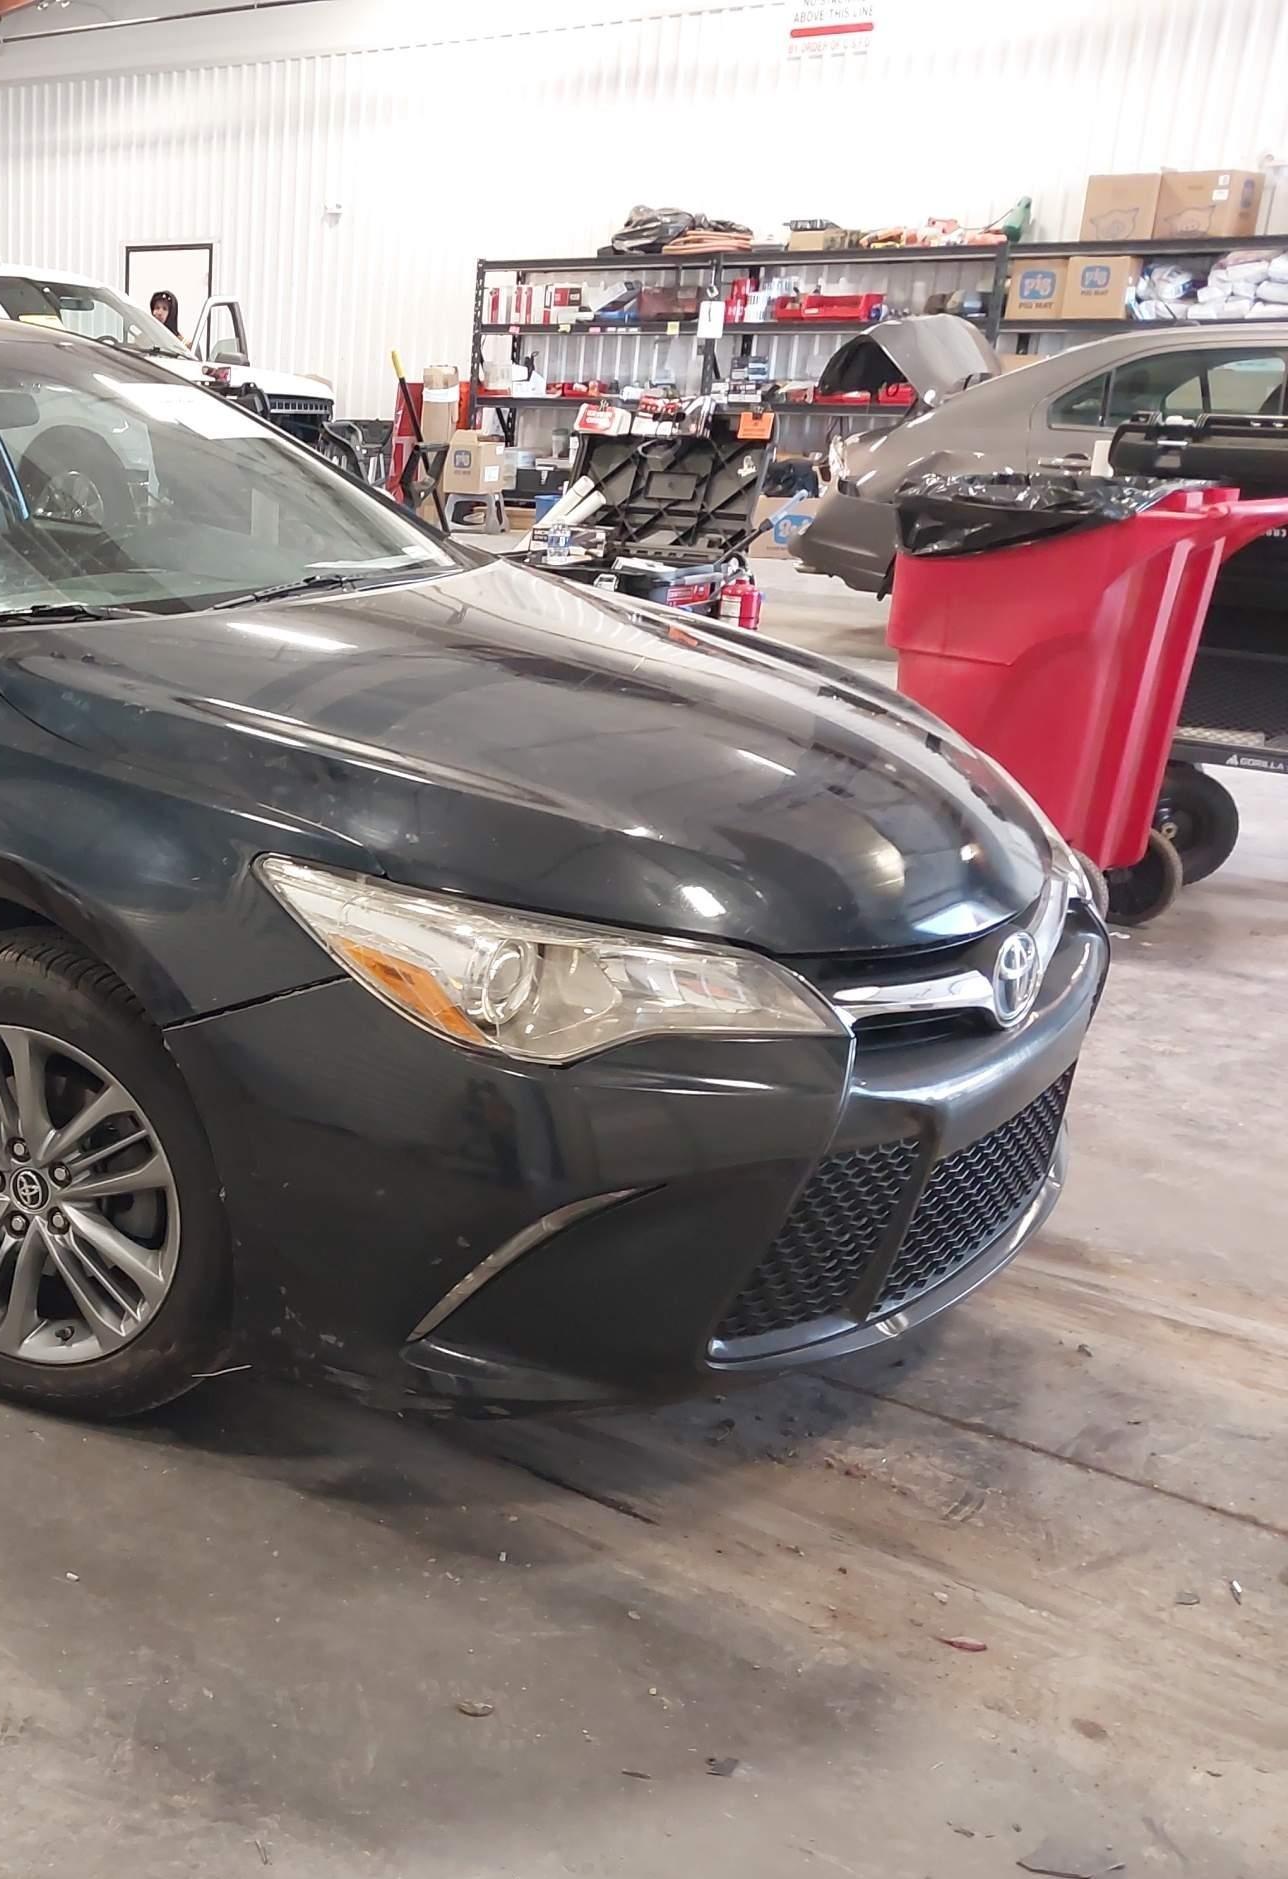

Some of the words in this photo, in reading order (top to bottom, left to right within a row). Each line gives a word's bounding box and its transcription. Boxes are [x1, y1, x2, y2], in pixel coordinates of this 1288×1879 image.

[793, 10, 824, 23] ABOVE
[829, 7, 850, 18] THIS
[1240, 757, 1285, 769] GORILLA
